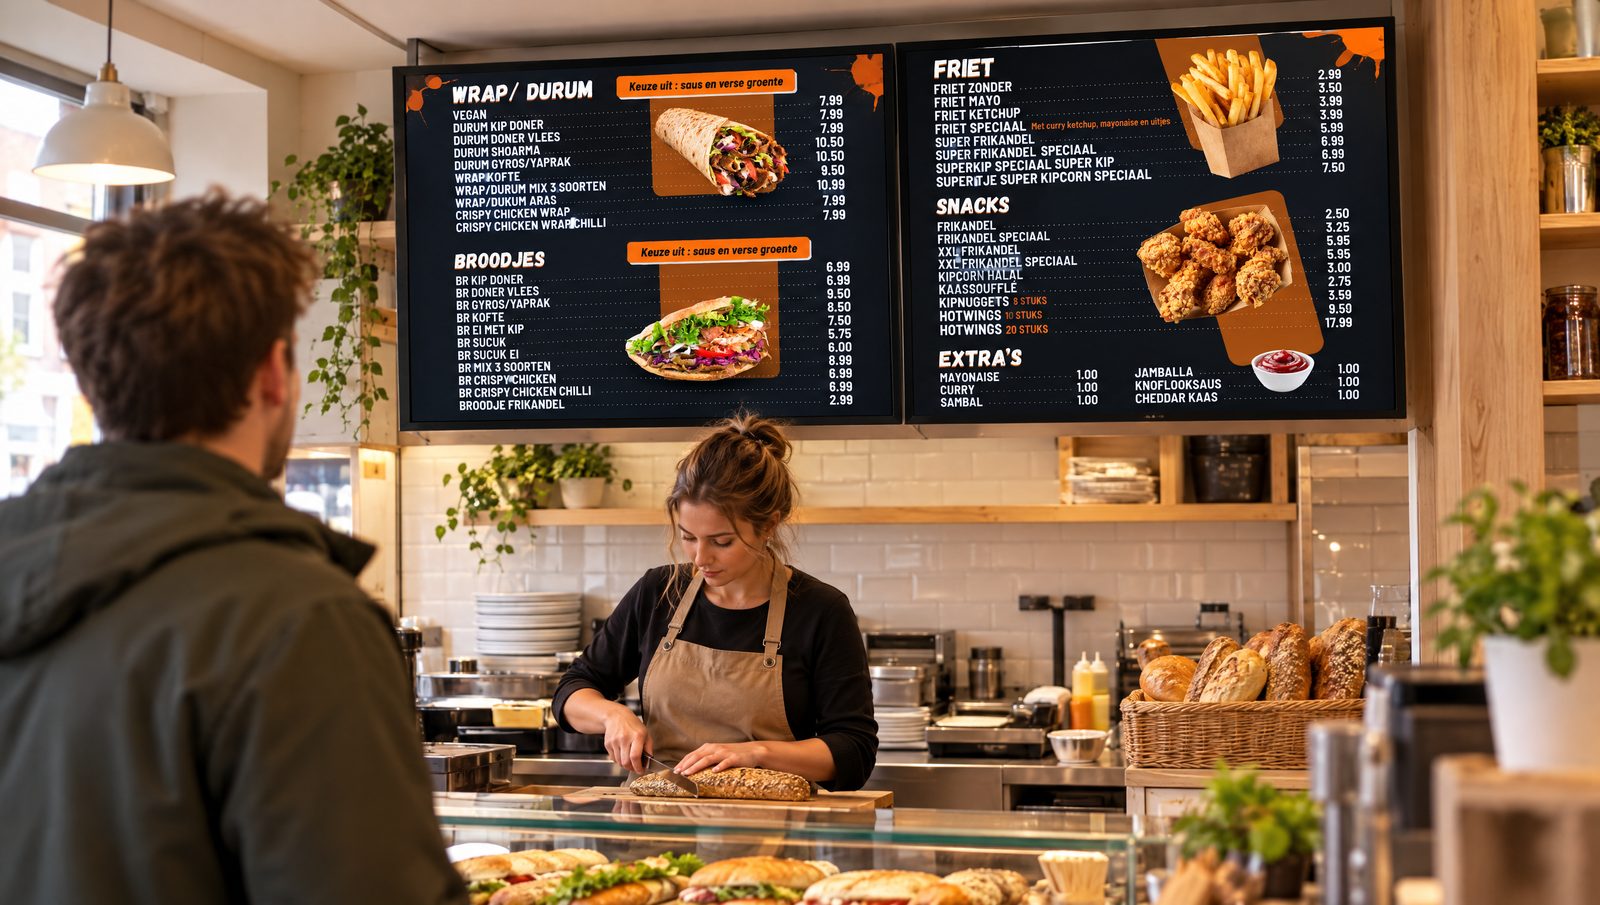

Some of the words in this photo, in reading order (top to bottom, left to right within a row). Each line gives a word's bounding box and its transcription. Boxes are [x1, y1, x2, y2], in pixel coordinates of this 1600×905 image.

[934, 57, 994, 78] FRIET
[1318, 69, 1341, 80] 2.99
[629, 82, 658, 91] Keuze
[660, 80, 673, 90] uit
[681, 82, 702, 90] saus
[705, 81, 716, 89] en
[719, 80, 744, 88] verse
[747, 77, 783, 89] groente
[934, 83, 965, 95] FRIET
[968, 81, 1012, 93] ZONDER
[1319, 82, 1342, 93] 3.50
[526, 80, 593, 101] DURUM
[819, 95, 843, 106] 7.99
[934, 96, 966, 108] FRIET
[969, 95, 1000, 107] MAYO
[1319, 95, 1342, 107] 3.99
[453, 109, 486, 120] VEGAN
[820, 108, 843, 120] 7.99
[935, 110, 966, 121] FRIET
[969, 107, 1021, 120] KETCHUP
[1320, 109, 1343, 120] 3.99
[453, 122, 488, 133] DURUM
[490, 121, 507, 131] KIP
[510, 119, 544, 130] DONER
[820, 122, 843, 134] 7.99
[935, 123, 967, 135] FRIET
[970, 121, 1027, 133] SPECIAAL
[1046, 122, 1065, 131] curry
[1067, 120, 1099, 130] ketchup,
[1100, 118, 1139, 129] mayonaise
[1321, 122, 1343, 133] 5.99
[454, 134, 488, 145] DURUM
[491, 133, 525, 144] DONER
[527, 132, 560, 143] VLEES
[815, 136, 844, 148] 10.50
[935, 136, 970, 148] SUPER
[974, 134, 1035, 146] FRIKANDEL
[1321, 135, 1344, 146] 6.99
[454, 147, 489, 158] DURUM
[491, 145, 540, 157] SHOARMA
[816, 150, 844, 162] 10.50
[936, 149, 971, 161] SUPER
[974, 146, 1036, 159] FRIKANDEL
[1041, 144, 1097, 156] SPECIAAL
[1322, 148, 1344, 159] 6.99
[454, 160, 489, 171] DURUM
[491, 157, 571, 169] GYROS/YAPRAK
[936, 161, 992, 174] SUPERKIP
[995, 159, 1052, 172] SPECIAAL
[1055, 157, 1092, 169] SUPER
[1096, 156, 1114, 168] KIP
[1322, 162, 1345, 173] 7.50
[821, 164, 845, 176] 9.50
[1000, 173, 1037, 185] SUPER
[1041, 171, 1091, 183] KIPCORN
[1094, 169, 1152, 181] SPECIAAL
[455, 184, 526, 196] WRAP/DURUM
[529, 183, 547, 193] MIX
[559, 181, 606, 192] SOORTEN
[817, 179, 845, 190] 10.99
[529, 195, 557, 206] ARAS
[822, 195, 845, 206] 7.99
[936, 196, 1009, 215] SNACKS
[456, 210, 491, 220] CRISPY
[494, 208, 537, 219] CHICKEN
[540, 207, 570, 217] WRAP
[823, 209, 846, 220] 7.99
[1325, 208, 1349, 219] 2.50
[456, 222, 492, 233] CRISPY
[494, 220, 538, 231] CHICKEN
[937, 220, 996, 232] FRIKANDEL
[1326, 221, 1350, 232] 3.25
[938, 233, 996, 244] FRIKANDEL
[999, 231, 1050, 242] SPECIAAL
[1327, 235, 1350, 246] 5.95
[641, 248, 670, 257] Keuze
[672, 246, 686, 256] uit
[693, 248, 715, 256] saus
[760, 245, 798, 256] groente
[1327, 248, 1351, 259] 5.95
[454, 251, 545, 269] BROODJES
[1025, 255, 1077, 267] SPECIAAL
[826, 261, 850, 272] 6.99
[1327, 262, 1351, 273] 3.00
[456, 276, 469, 286] BR
[471, 275, 487, 285] KIP
[490, 274, 523, 285] DONER
[827, 275, 850, 286] 6.99
[1328, 275, 1351, 287] 2.75
[456, 288, 469, 298] BR
[471, 287, 505, 297] DONER
[507, 286, 539, 296] VLEES
[939, 280, 1017, 295] KAASSOUFFLÉ
[827, 288, 851, 299] 9.50
[1328, 289, 1352, 300] 3.59
[456, 300, 469, 310] BR
[472, 298, 550, 310] GYROS/YAPRAK
[939, 296, 1009, 308] KIPNUGGETS
[1021, 296, 1047, 305] STUKS
[827, 301, 851, 312] 8.50
[457, 313, 470, 323] BR
[472, 312, 504, 323] KOFTE
[828, 315, 851, 326] 7.50
[940, 310, 1001, 322] HOTWINGS
[1016, 311, 1042, 319] STUKS
[1325, 317, 1352, 328] 17.99
[457, 325, 470, 335] BR
[485, 324, 505, 335] MET
[508, 324, 524, 334] KIP
[828, 328, 851, 339] 5.75
[940, 323, 1002, 336] HOTWINGS
[1006, 325, 1017, 334] 20
[1019, 324, 1048, 334] STUKS
[457, 338, 470, 348] BR
[473, 337, 506, 348] SUCUK
[828, 342, 852, 352] 6.00
[458, 350, 471, 360] BR
[473, 349, 506, 360] SUCUK
[939, 348, 1022, 367] EXTRA'S
[829, 355, 852, 366] 8.99
[458, 363, 471, 373] BR
[474, 362, 492, 372] MIX
[504, 361, 551, 372] SOORTEN
[1135, 367, 1193, 378] JAMBALLA
[1338, 363, 1359, 374] 1.00
[829, 368, 852, 379] 6.99
[940, 372, 999, 383] MAYONAISE
[1077, 369, 1098, 380] 1.00
[459, 375, 472, 385] BR
[1135, 379, 1222, 391] KNOFLOOKSAUS
[1338, 376, 1359, 387] 1.00
[459, 388, 472, 398] BR
[474, 387, 510, 398] CRISPY
[512, 386, 556, 397] CHICKEN
[559, 386, 591, 396] CHILLI
[829, 381, 853, 392] 6.99
[940, 385, 975, 395] CURRY
[1077, 382, 1098, 392] 1.00
[829, 394, 853, 405] 2.99
[1077, 395, 1098, 405] 1.00
[1135, 393, 1185, 404] CHEDDAR
[1188, 392, 1218, 402] KAAS
[1338, 389, 1359, 400] 1.00
[459, 400, 506, 411] BROODJE
[508, 399, 565, 410] FRIKANDEL
[941, 397, 983, 407] SAMBAL
